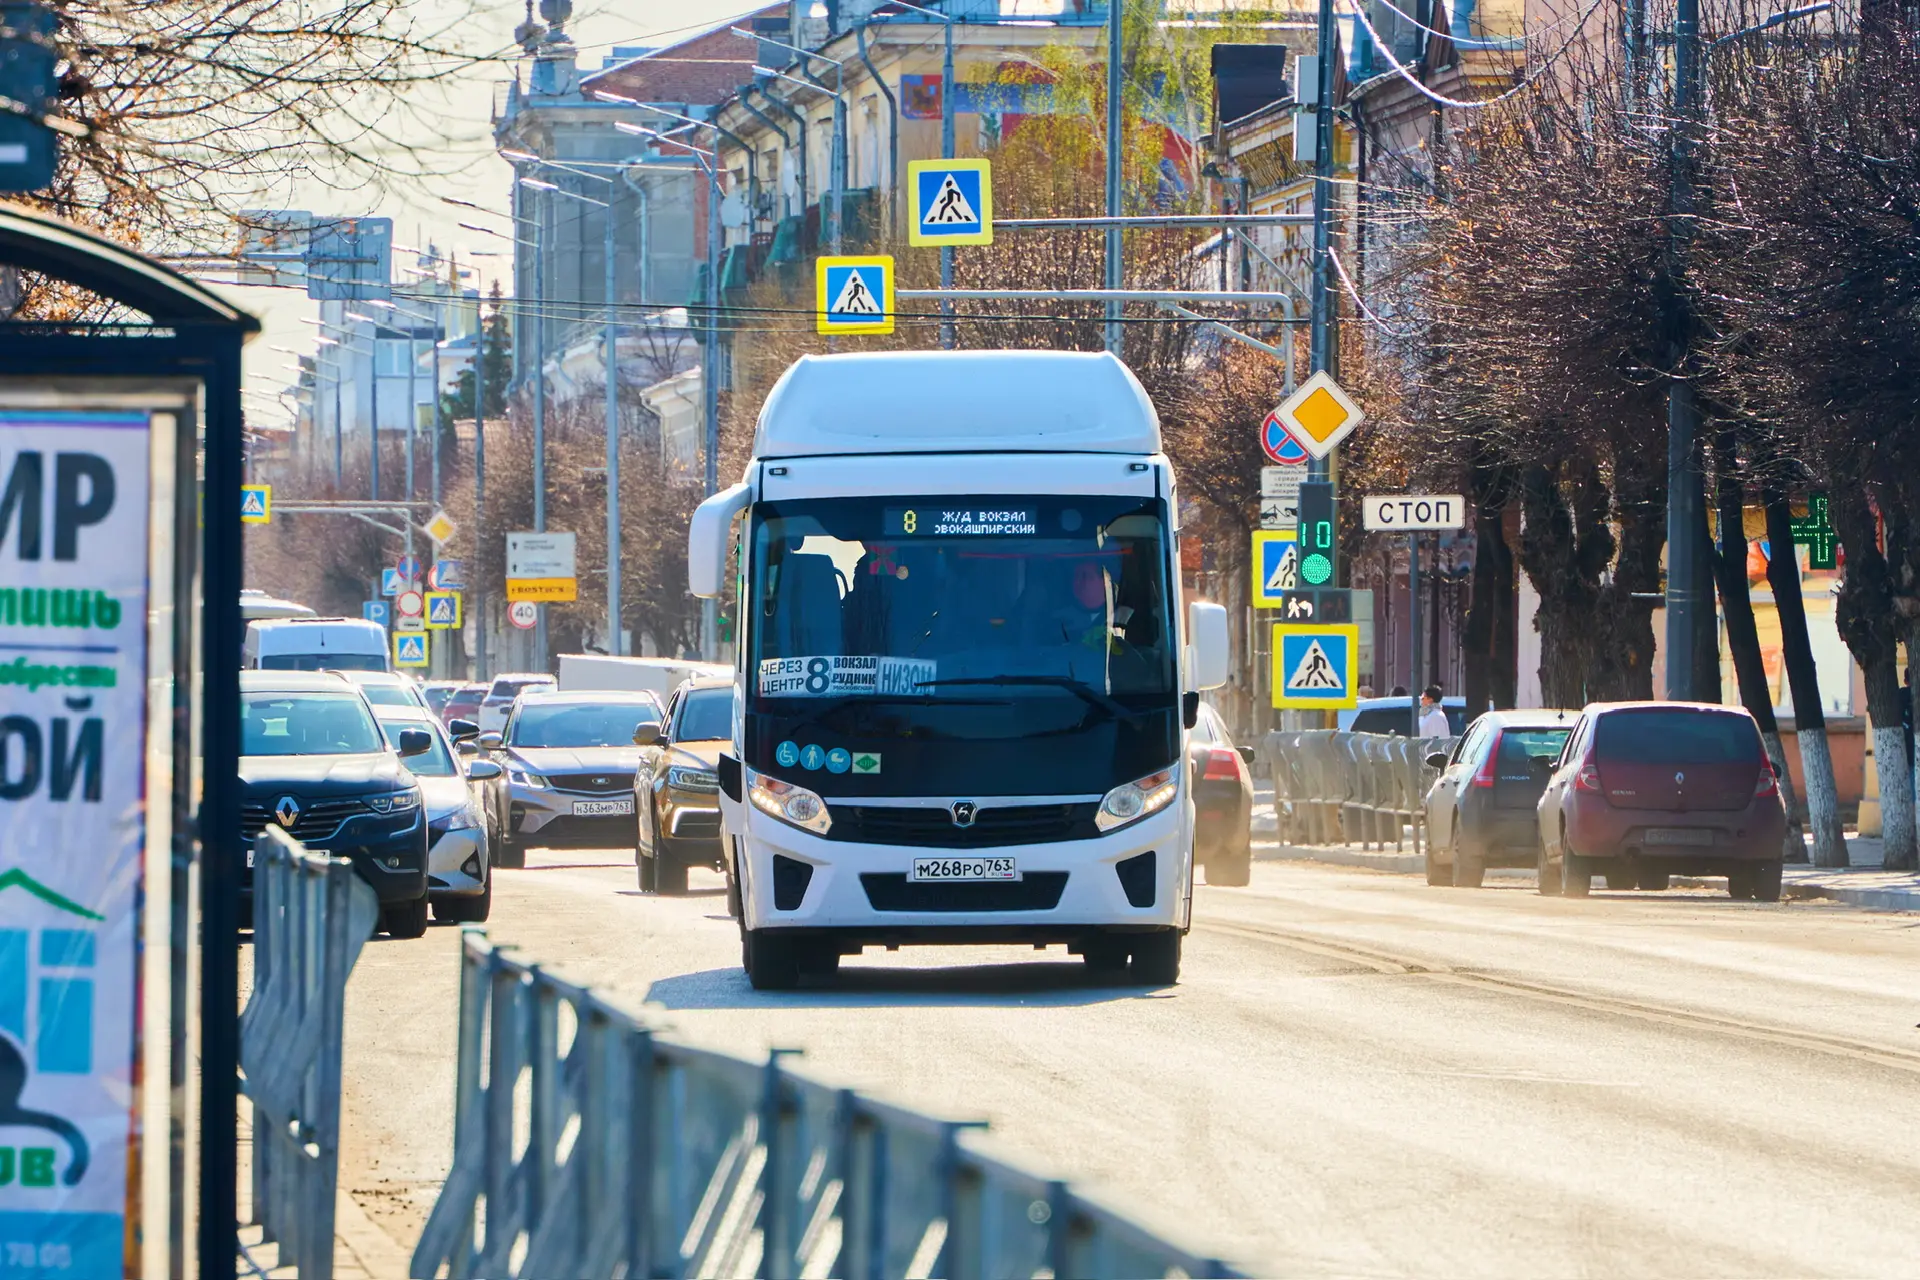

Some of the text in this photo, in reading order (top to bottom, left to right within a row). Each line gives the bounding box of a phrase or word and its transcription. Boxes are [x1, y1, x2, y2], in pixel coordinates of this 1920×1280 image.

[903, 509, 917, 534] 8
[942, 511, 1026, 523] Ж/Д ВОКЗАЛ
[1378, 501, 1450, 524] СТОП
[1302, 521, 1331, 549] 10
[515, 605, 534, 618] 40
[761, 659, 803, 676] ЧЕРЕЗ
[833, 657, 877, 669] ВОКЗАЛ
[805, 657, 830, 694] 8
[832, 673, 876, 686] РУДНИК
[762, 677, 804, 696] ЦЕНТР
[919, 859, 1010, 877] М268РО 763
